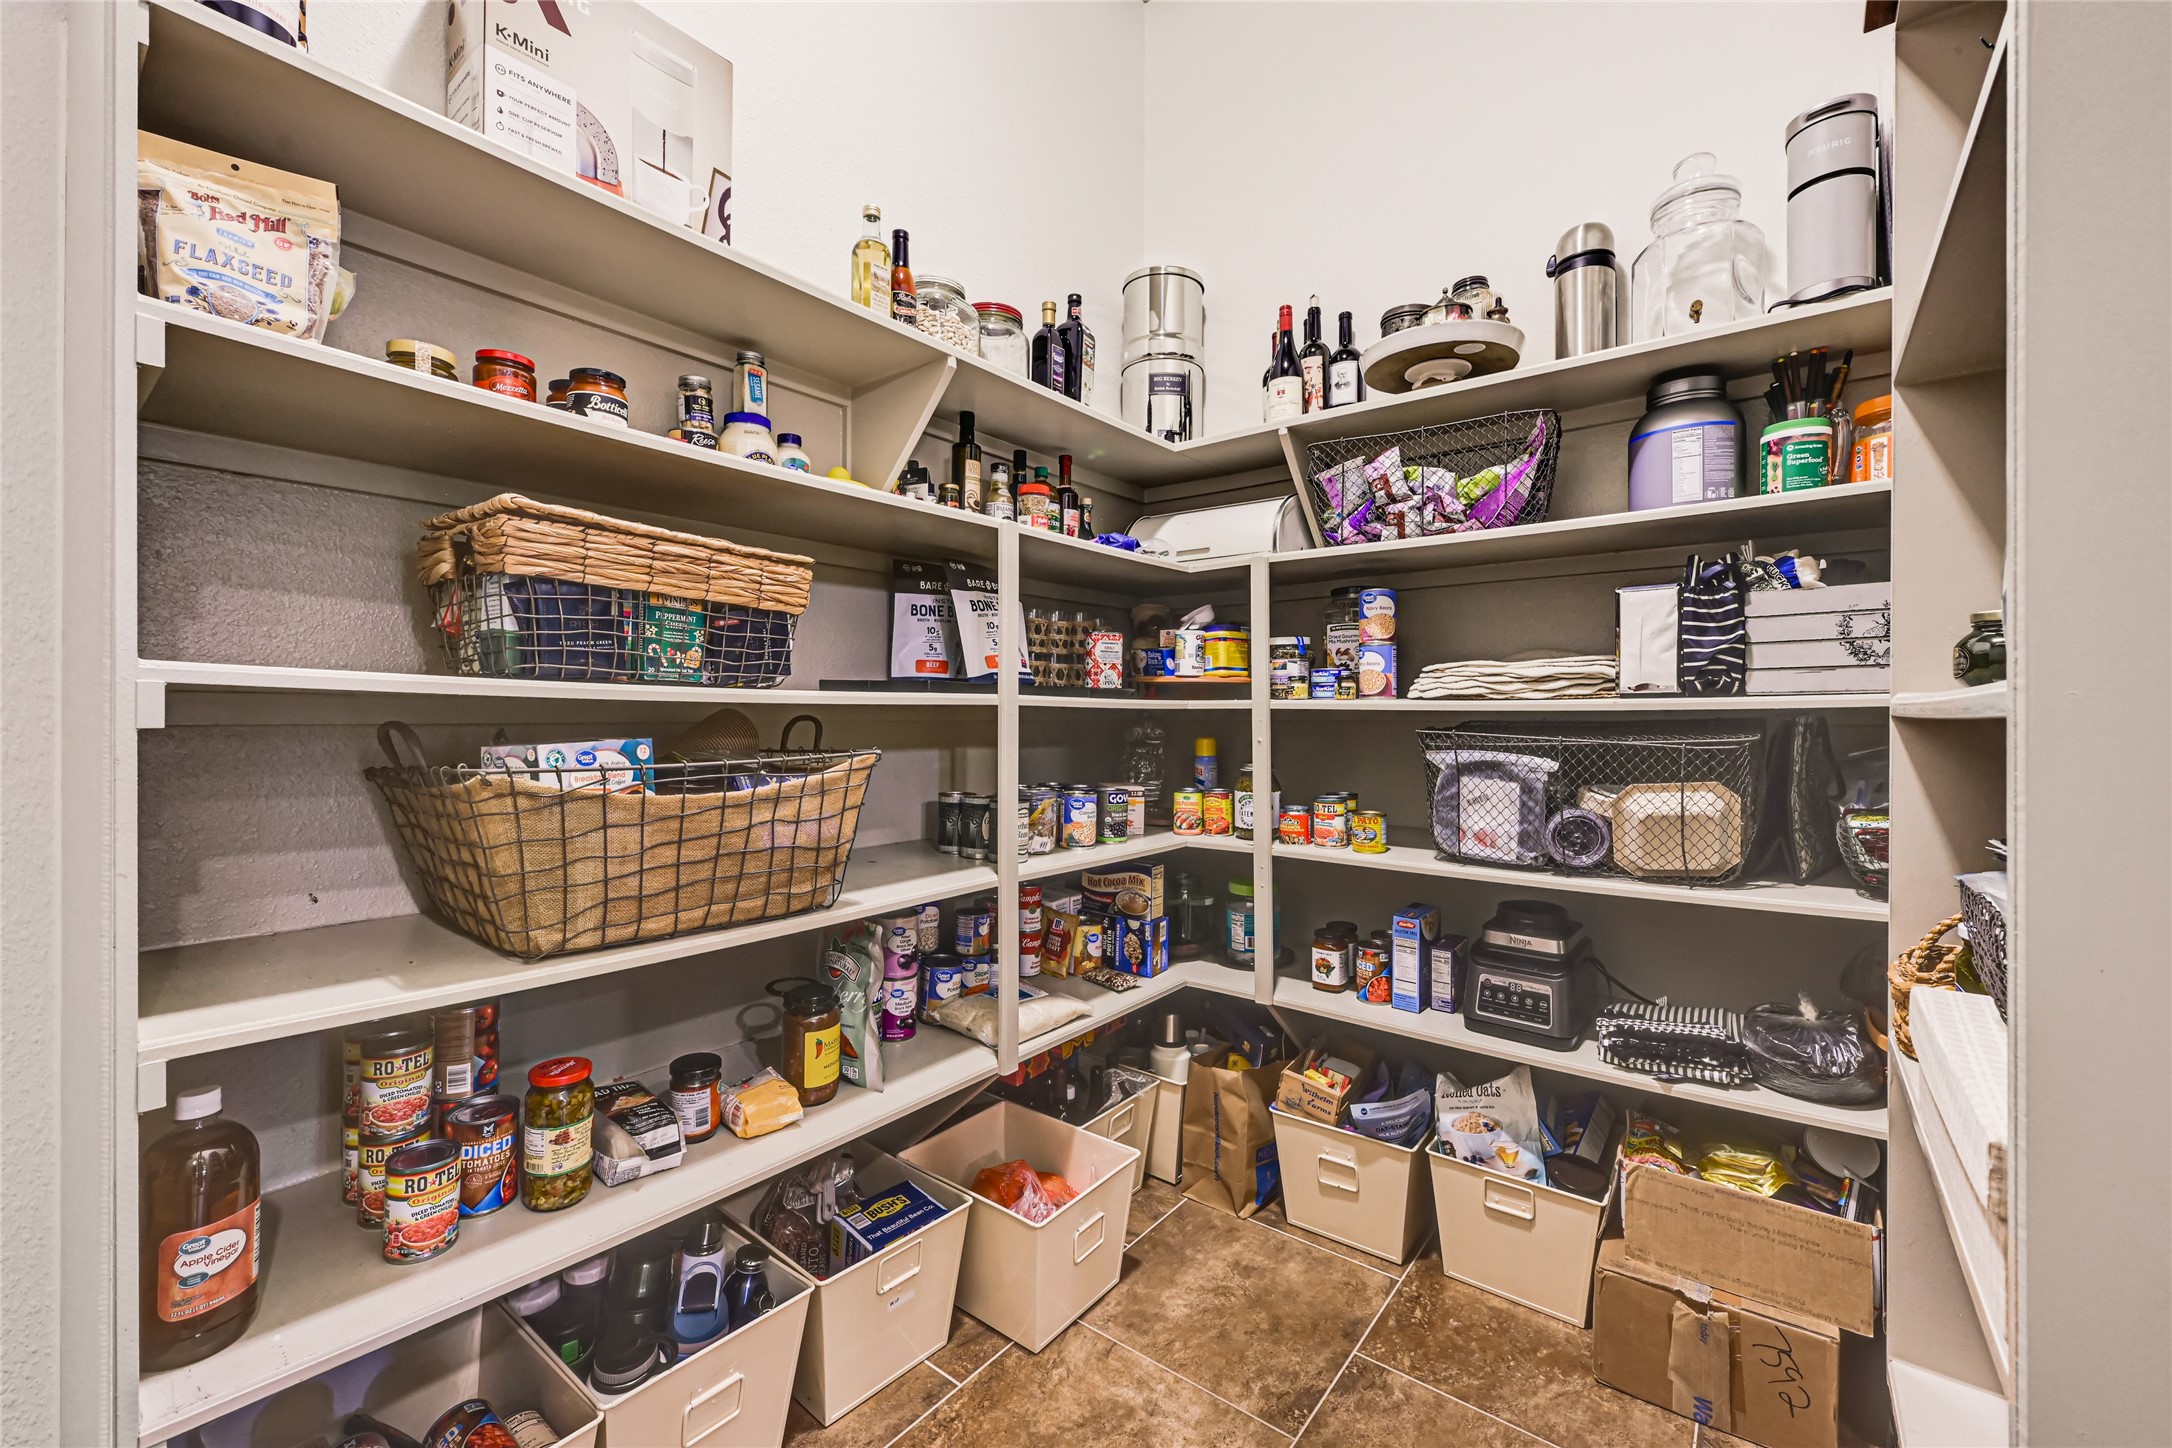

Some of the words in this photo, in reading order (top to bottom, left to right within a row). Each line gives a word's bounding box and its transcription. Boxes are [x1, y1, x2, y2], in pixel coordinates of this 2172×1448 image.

[508, 69, 526, 83] FITS
[527, 78, 572, 106] ANYWHERE
[508, 95, 524, 106] YOUR
[524, 100, 548, 117] PERFECT
[548, 115, 572, 129] AMOUNT
[508, 110, 533, 124] ONE-CUP
[534, 121, 563, 139] RESERVOIR
[508, 126, 520, 137] FAST
[526, 135, 542, 148] FRESH
[542, 142, 563, 156] BREWED
[1807, 136, 1852, 158] KEURIG
[209, 205, 247, 225] Red
[248, 213, 288, 234] Mill
[173, 238, 293, 289] FLAXSEED
[492, 382, 530, 396] Mezzetta
[1786, 457, 1822, 466] Superfood
[920, 581, 942, 590] BARE
[967, 578, 986, 589] BARE
[910, 604, 944, 618] BONE
[970, 600, 998, 612] BONE
[928, 644, 938, 652] 5g
[577, 754, 594, 762] Great
[1087, 876, 1100, 887] Hot
[1103, 877, 1126, 887] Cocoa
[1128, 876, 1146, 888] Mix
[1509, 936, 1532, 948] NINJA
[1510, 982, 1522, 992] 88
[380, 1072, 424, 1087] Original
[379, 1091, 396, 1100] DICED
[396, 1084, 423, 1096] TOMATOES
[386, 1094, 404, 1102] GREEN
[404, 1090, 422, 1099] CHILIES
[1301, 1082, 1334, 1106] Wilhelm
[1476, 1082, 1502, 1098] Oats
[1306, 1098, 1332, 1116] Farms
[462, 1135, 512, 1160] DICED
[462, 1150, 510, 1169] TOMATOES
[474, 1164, 492, 1172] TOMATO
[412, 1185, 456, 1205] Original
[411, 1207, 428, 1218] DICED
[429, 1198, 456, 1212] TOMATOES
[419, 1210, 436, 1220] GREEN
[437, 1204, 453, 1214] CHILIES
[868, 1194, 910, 1220] BUSH'S
[886, 1207, 897, 1216] BEST
[866, 1228, 883, 1240] That
[883, 1216, 908, 1234] Beautiful
[908, 1210, 922, 1220] Bean
[922, 1204, 934, 1214] Co.
[1714, 1214, 1725, 1222] for
[1727, 1218, 1744, 1227] using
[1822, 1216, 1840, 1226] you
[182, 1239, 206, 1250] Great
[180, 1254, 214, 1269] Apple
[216, 1240, 240, 1256] Cider
[204, 1248, 240, 1268] Vinegar
[1700, 1323, 1708, 1344] today
